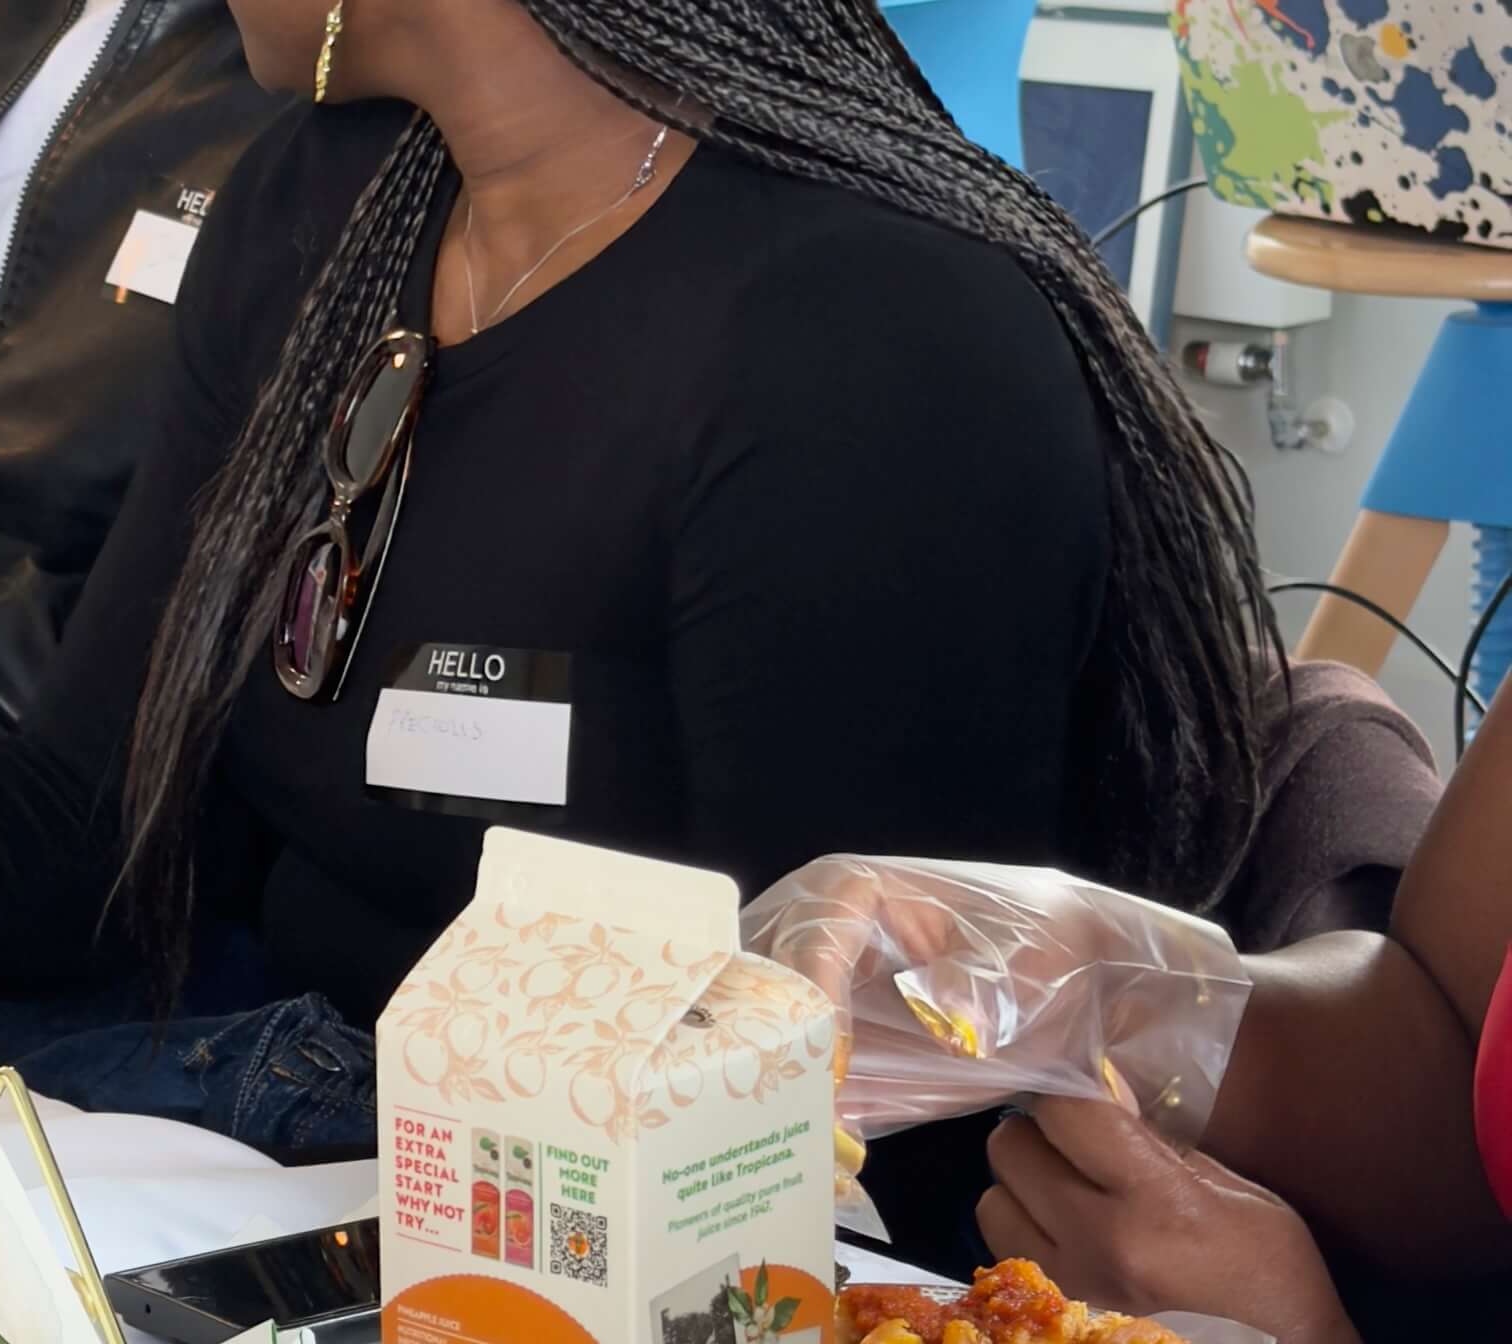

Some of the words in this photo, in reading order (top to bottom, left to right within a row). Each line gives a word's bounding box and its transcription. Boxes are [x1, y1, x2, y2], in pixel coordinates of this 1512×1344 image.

[428, 649, 505, 682] HELLO
[395, 1118, 425, 1137] FOR
[431, 1129, 453, 1143] AN
[395, 1136, 446, 1160] EXTRA
[547, 1145, 577, 1164] FIND
[580, 1154, 609, 1172] OUT
[662, 1160, 706, 1184] No-one
[709, 1131, 781, 1167] understands
[782, 1120, 810, 1143] juice
[395, 1155, 459, 1183] SPECIAL
[559, 1167, 597, 1187] MORE
[677, 1178, 708, 1201] quite
[711, 1169, 733, 1187] like
[737, 1148, 794, 1177] Tropicana.
[395, 1174, 443, 1197] START
[561, 1184, 596, 1204] HERE
[396, 1192, 431, 1212] WHY
[433, 1203, 464, 1222] NOT
